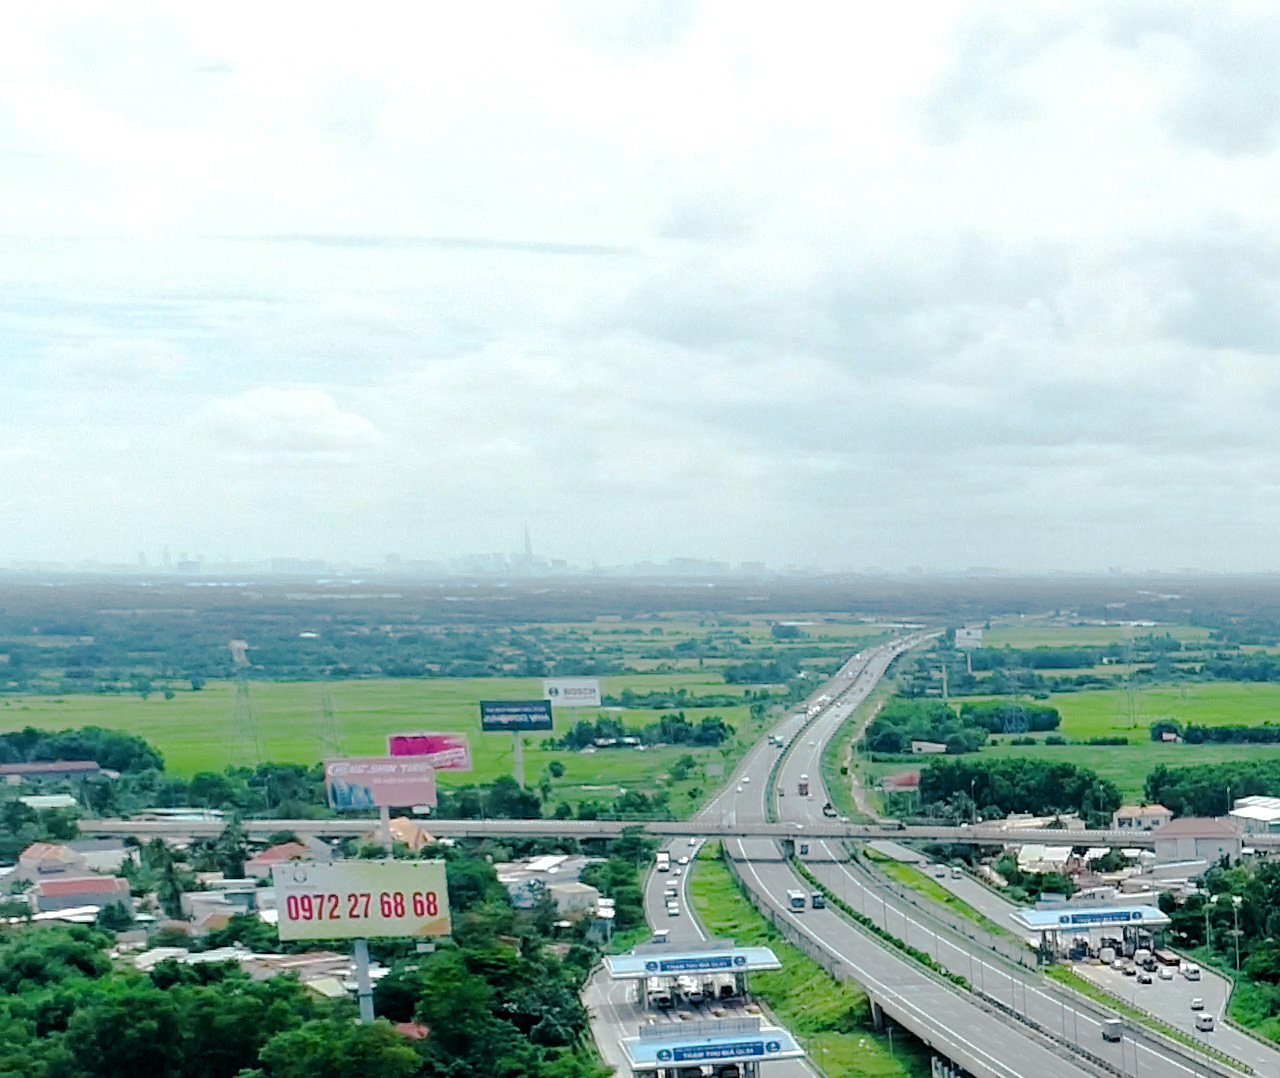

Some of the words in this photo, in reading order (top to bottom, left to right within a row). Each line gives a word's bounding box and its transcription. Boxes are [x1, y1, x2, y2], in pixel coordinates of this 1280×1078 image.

[286, 894, 340, 920] 0972
[347, 893, 371, 918] 27
[380, 891, 405, 918] 68
[412, 891, 438, 917] 68
